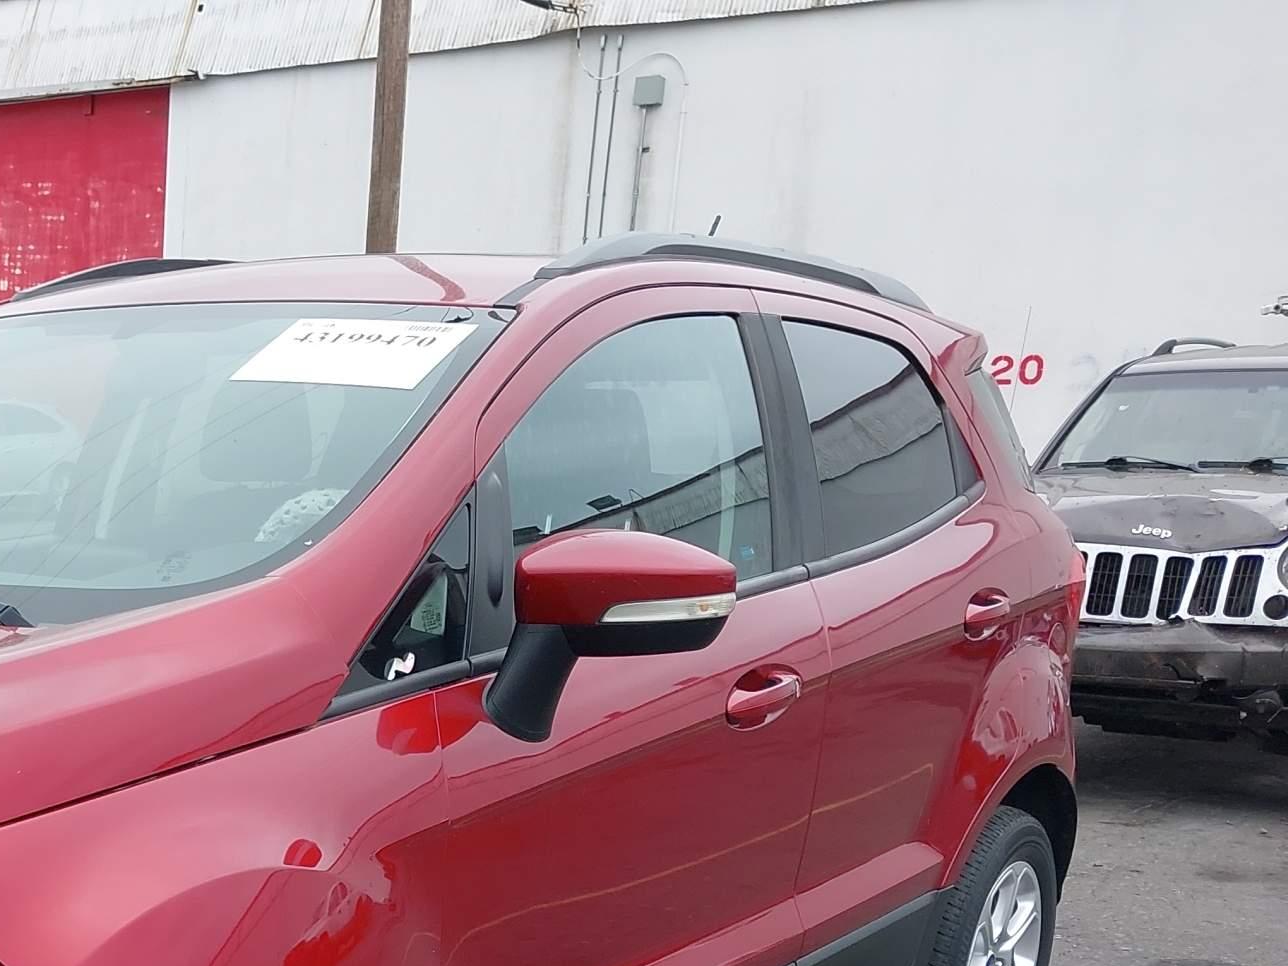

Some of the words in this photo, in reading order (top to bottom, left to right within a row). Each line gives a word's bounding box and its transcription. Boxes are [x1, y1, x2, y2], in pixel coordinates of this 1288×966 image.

[294, 331, 438, 348] 43199470
[990, 354, 1044, 386] 20
[1131, 524, 1173, 540] Jeep
